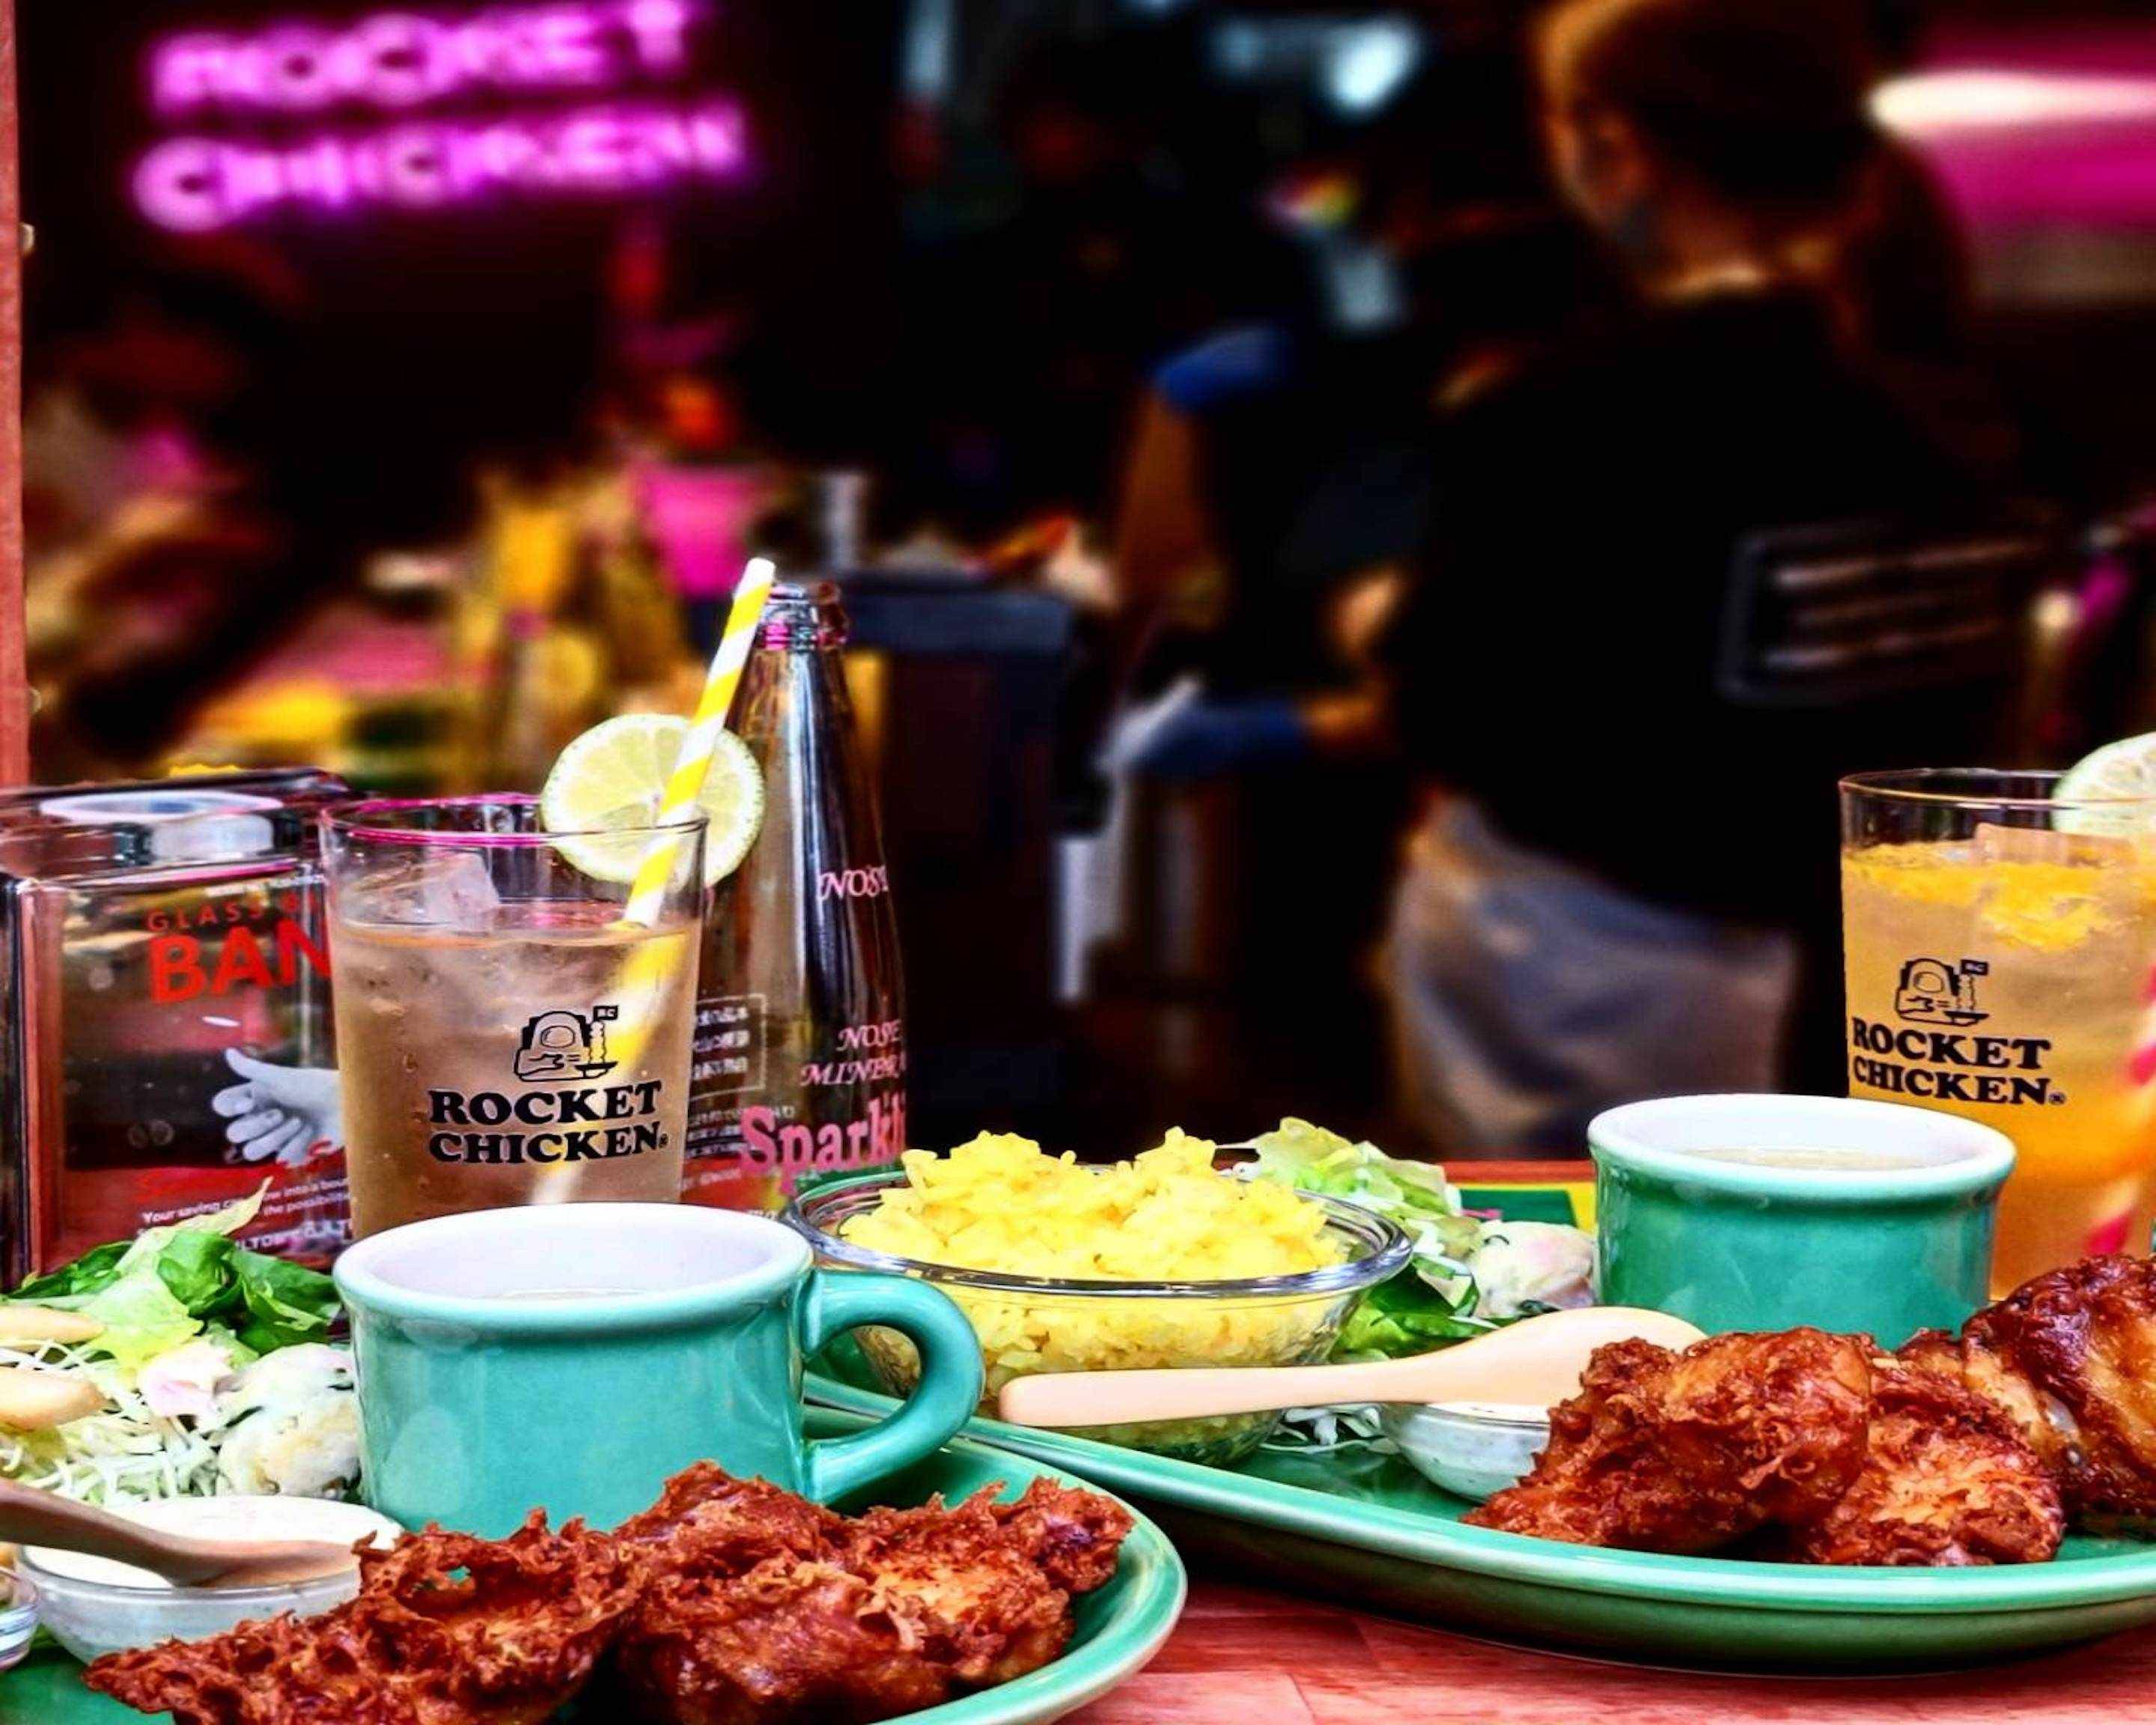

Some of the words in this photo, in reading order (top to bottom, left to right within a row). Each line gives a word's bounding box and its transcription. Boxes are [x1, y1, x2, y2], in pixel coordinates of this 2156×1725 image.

[817, 863, 889, 901] NOS
[1852, 1017, 2052, 1070] ROCKET
[428, 1080, 663, 1126] ROCKET
[1854, 1056, 2052, 1105] CHICKEN
[428, 1121, 662, 1163] CHICKEN
